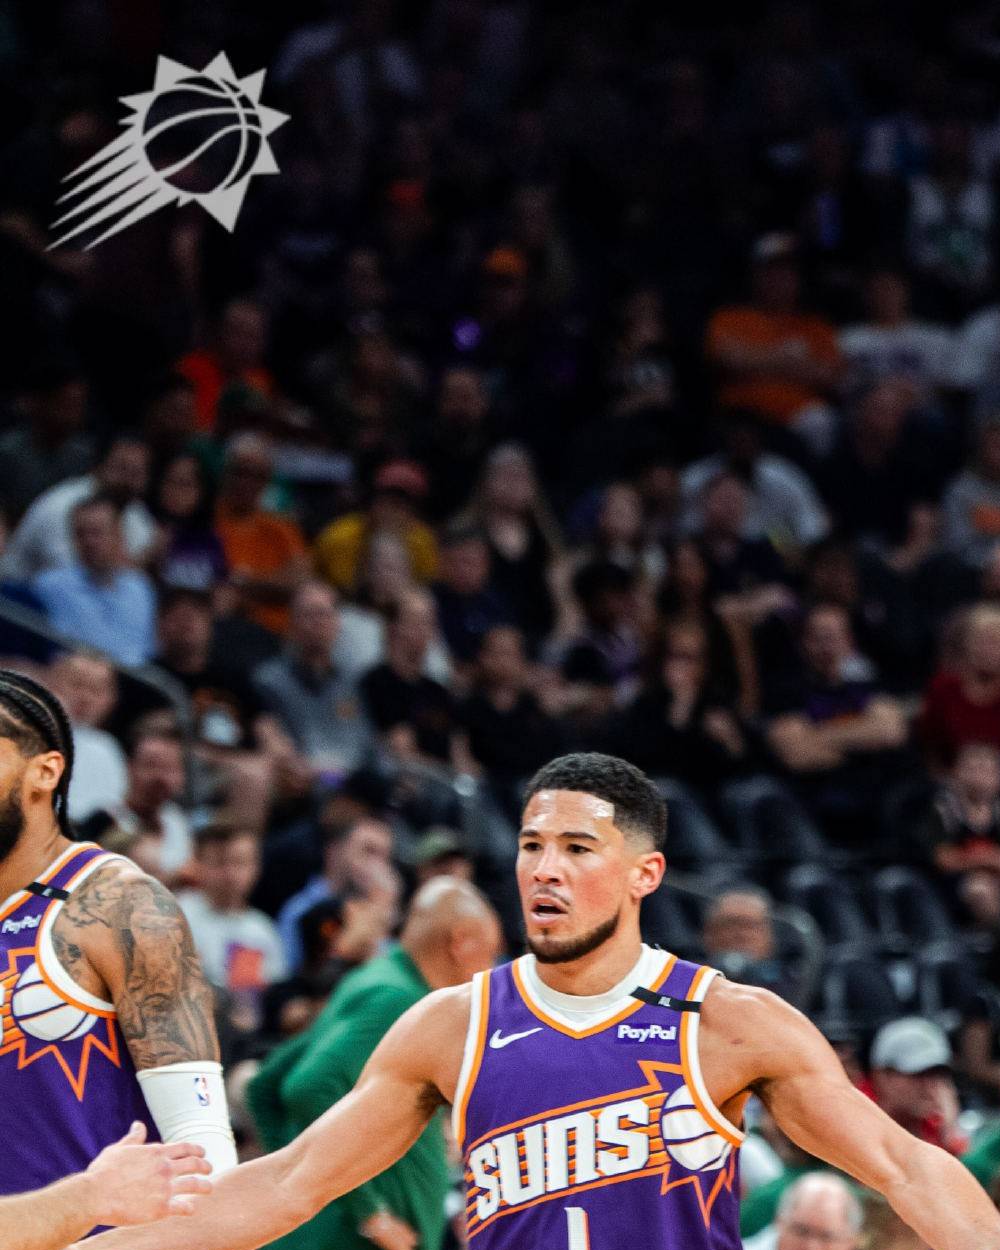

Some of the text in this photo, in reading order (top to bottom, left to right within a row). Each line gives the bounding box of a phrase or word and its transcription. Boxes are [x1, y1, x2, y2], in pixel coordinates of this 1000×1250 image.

[2, 915, 41, 934] PayPal
[618, 1025, 677, 1043] PayPal
[470, 1099, 649, 1220] SUNS
